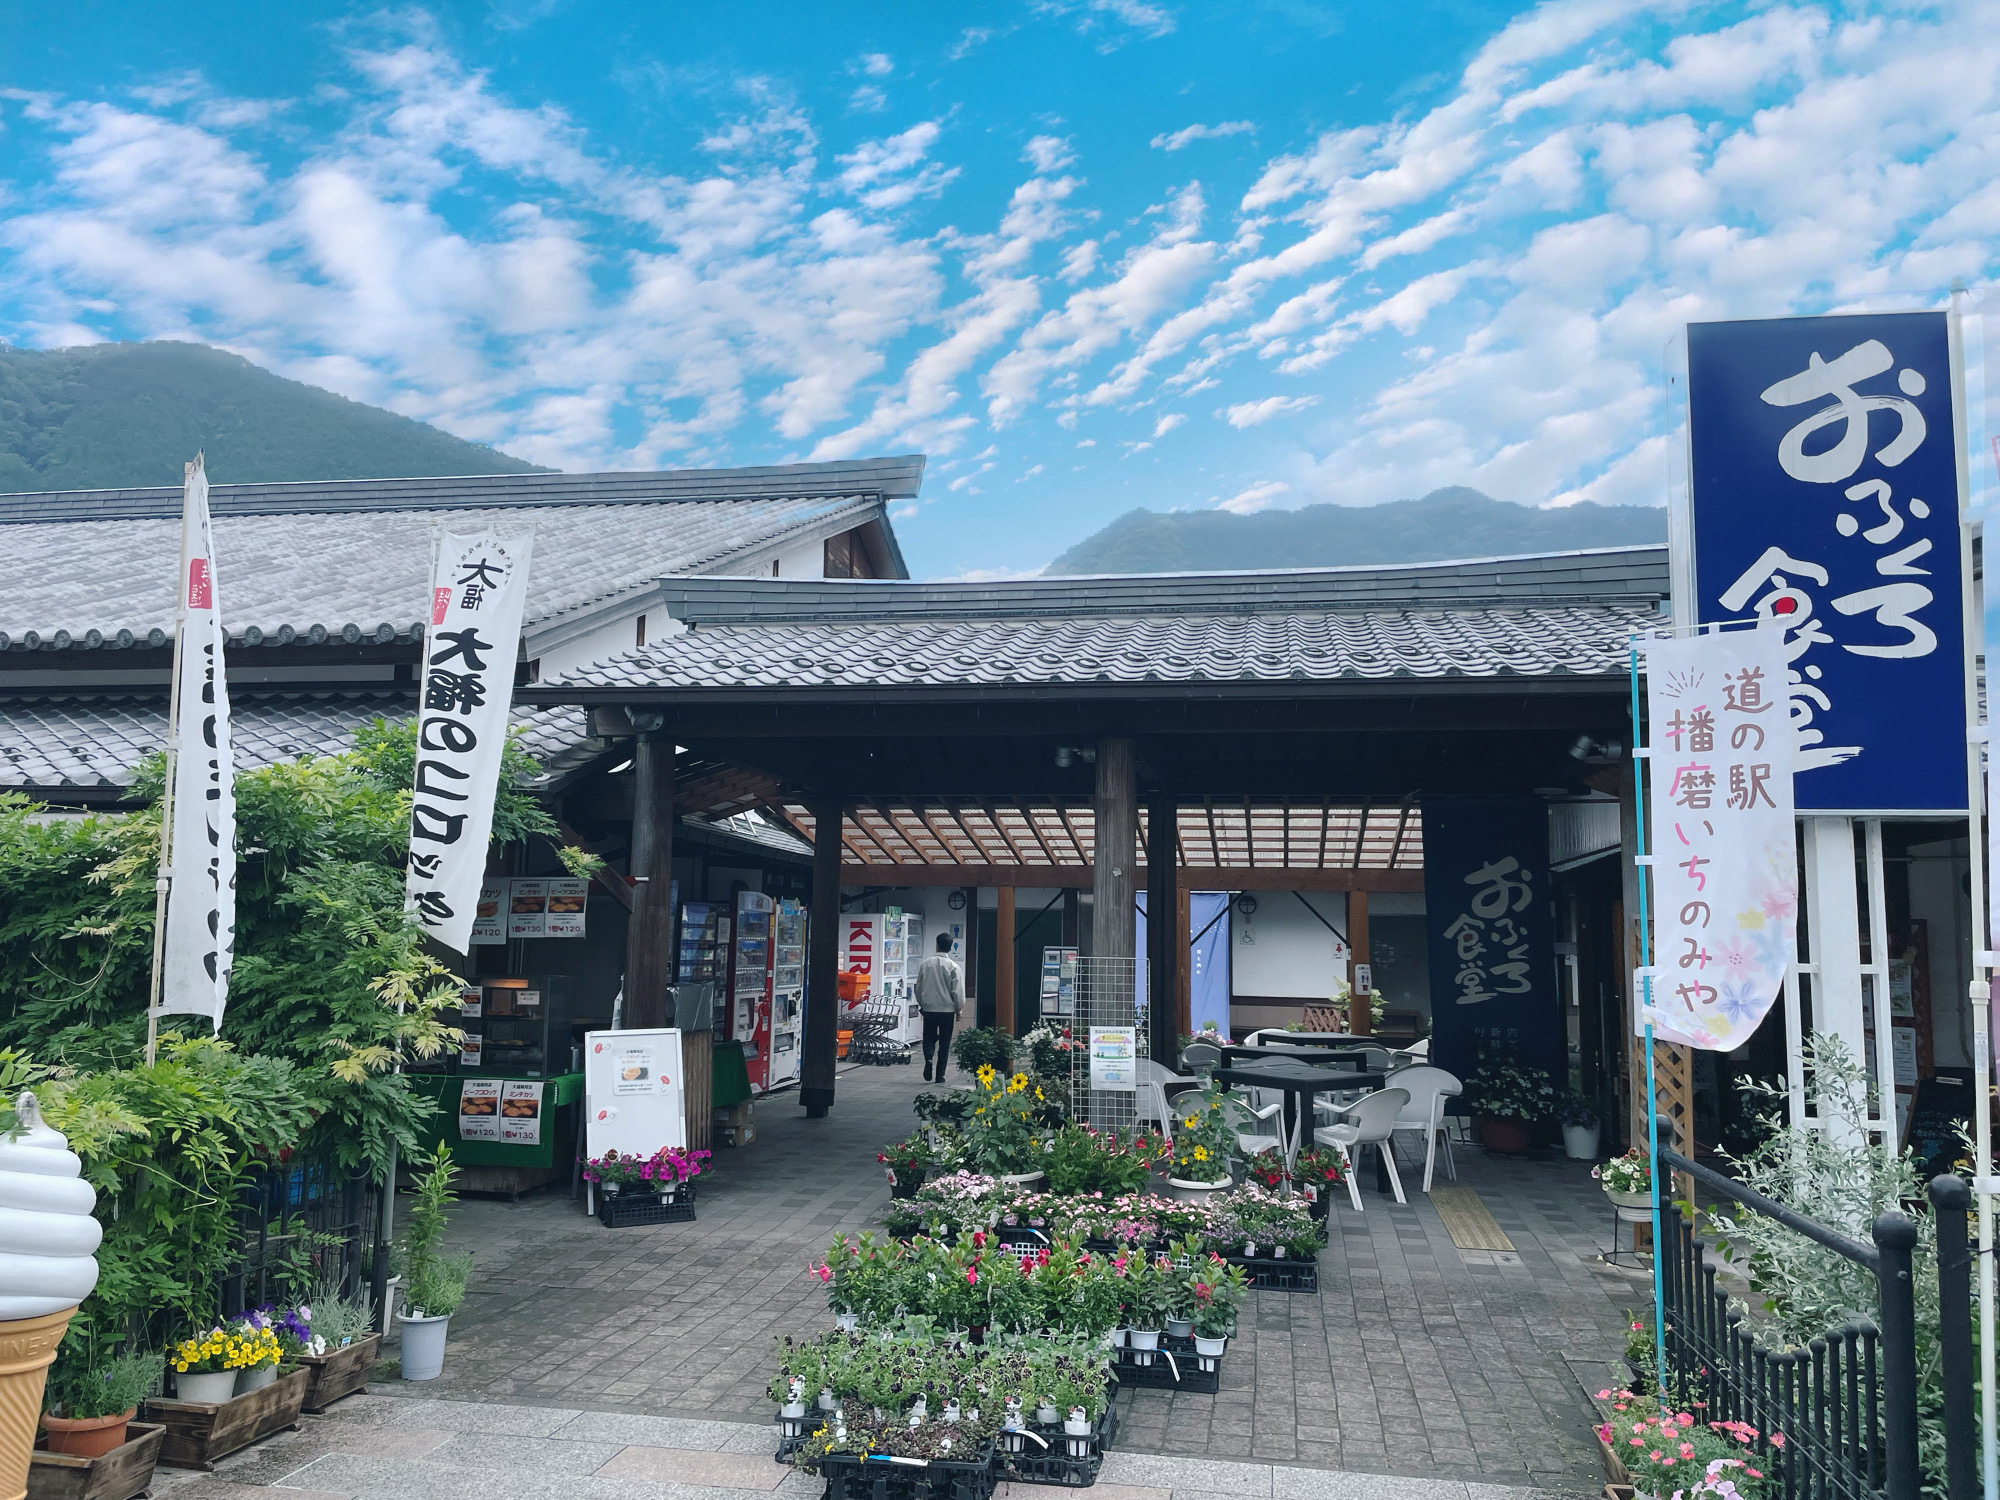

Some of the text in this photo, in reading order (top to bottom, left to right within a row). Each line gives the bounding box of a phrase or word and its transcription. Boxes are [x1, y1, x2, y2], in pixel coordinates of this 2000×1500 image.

[1760, 339, 1937, 659] おふくろ
[1722, 665, 1776, 811] 道の駅
[481, 889, 501, 899] カツ
[1464, 856, 1532, 993] おふくろ
[1665, 705, 1717, 1012] 播磨いちのみや
[1443, 913, 1498, 1005] 食堂
